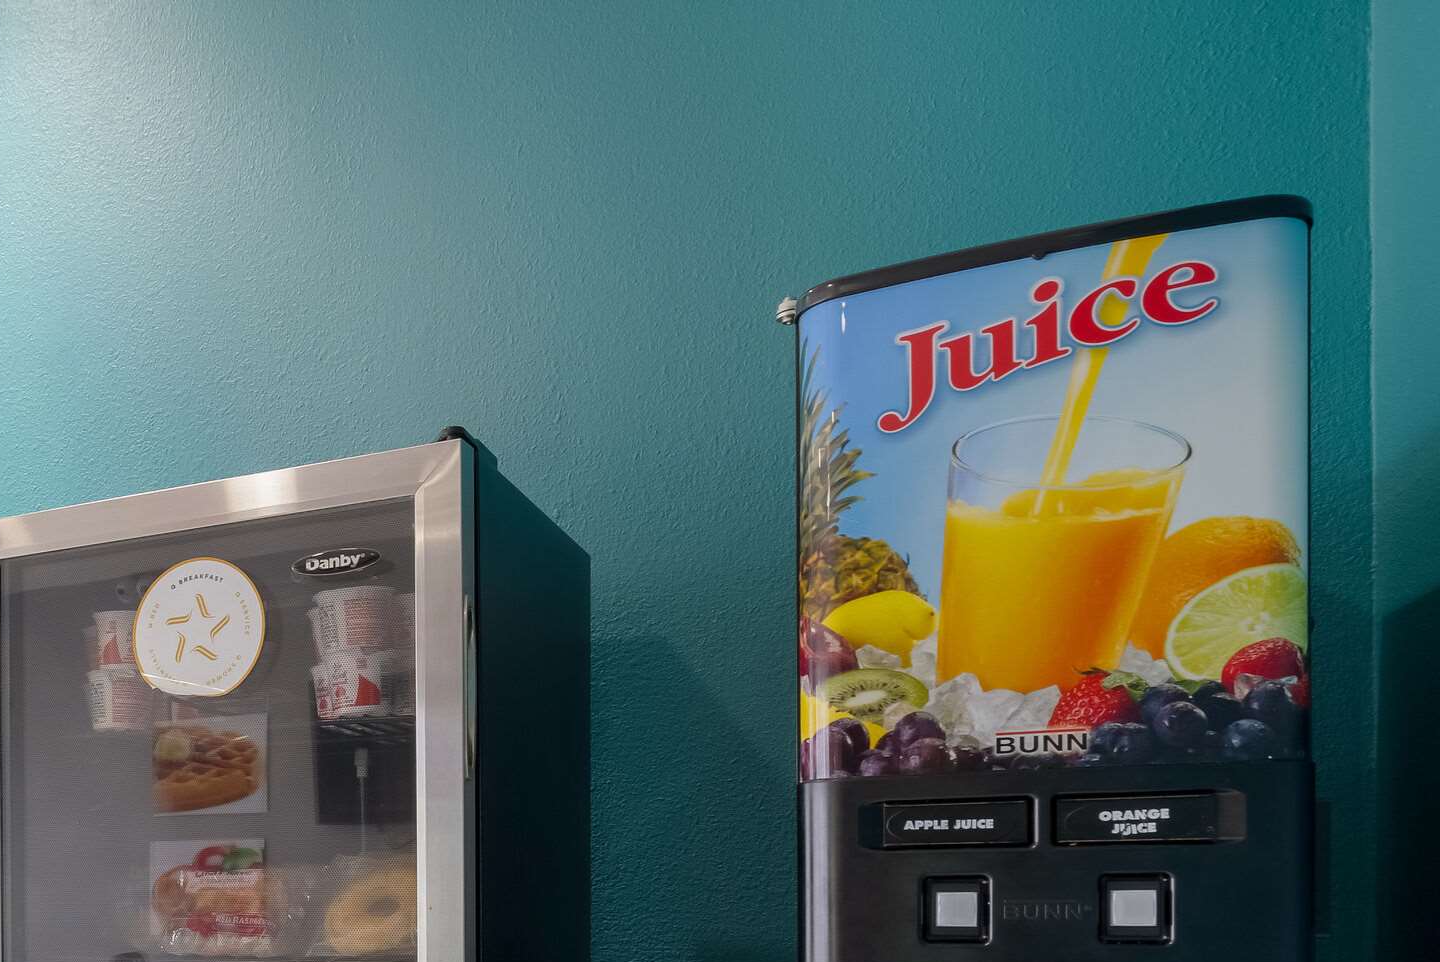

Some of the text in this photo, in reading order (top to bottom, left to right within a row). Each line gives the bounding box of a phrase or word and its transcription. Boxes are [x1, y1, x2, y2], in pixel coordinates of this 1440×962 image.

[877, 261, 1219, 433] Juice
[305, 554, 362, 571] Danby
[994, 732, 1089, 756] BUNN
[1098, 808, 1171, 822] ORANGE
[903, 818, 995, 831] APPLE JUICE
